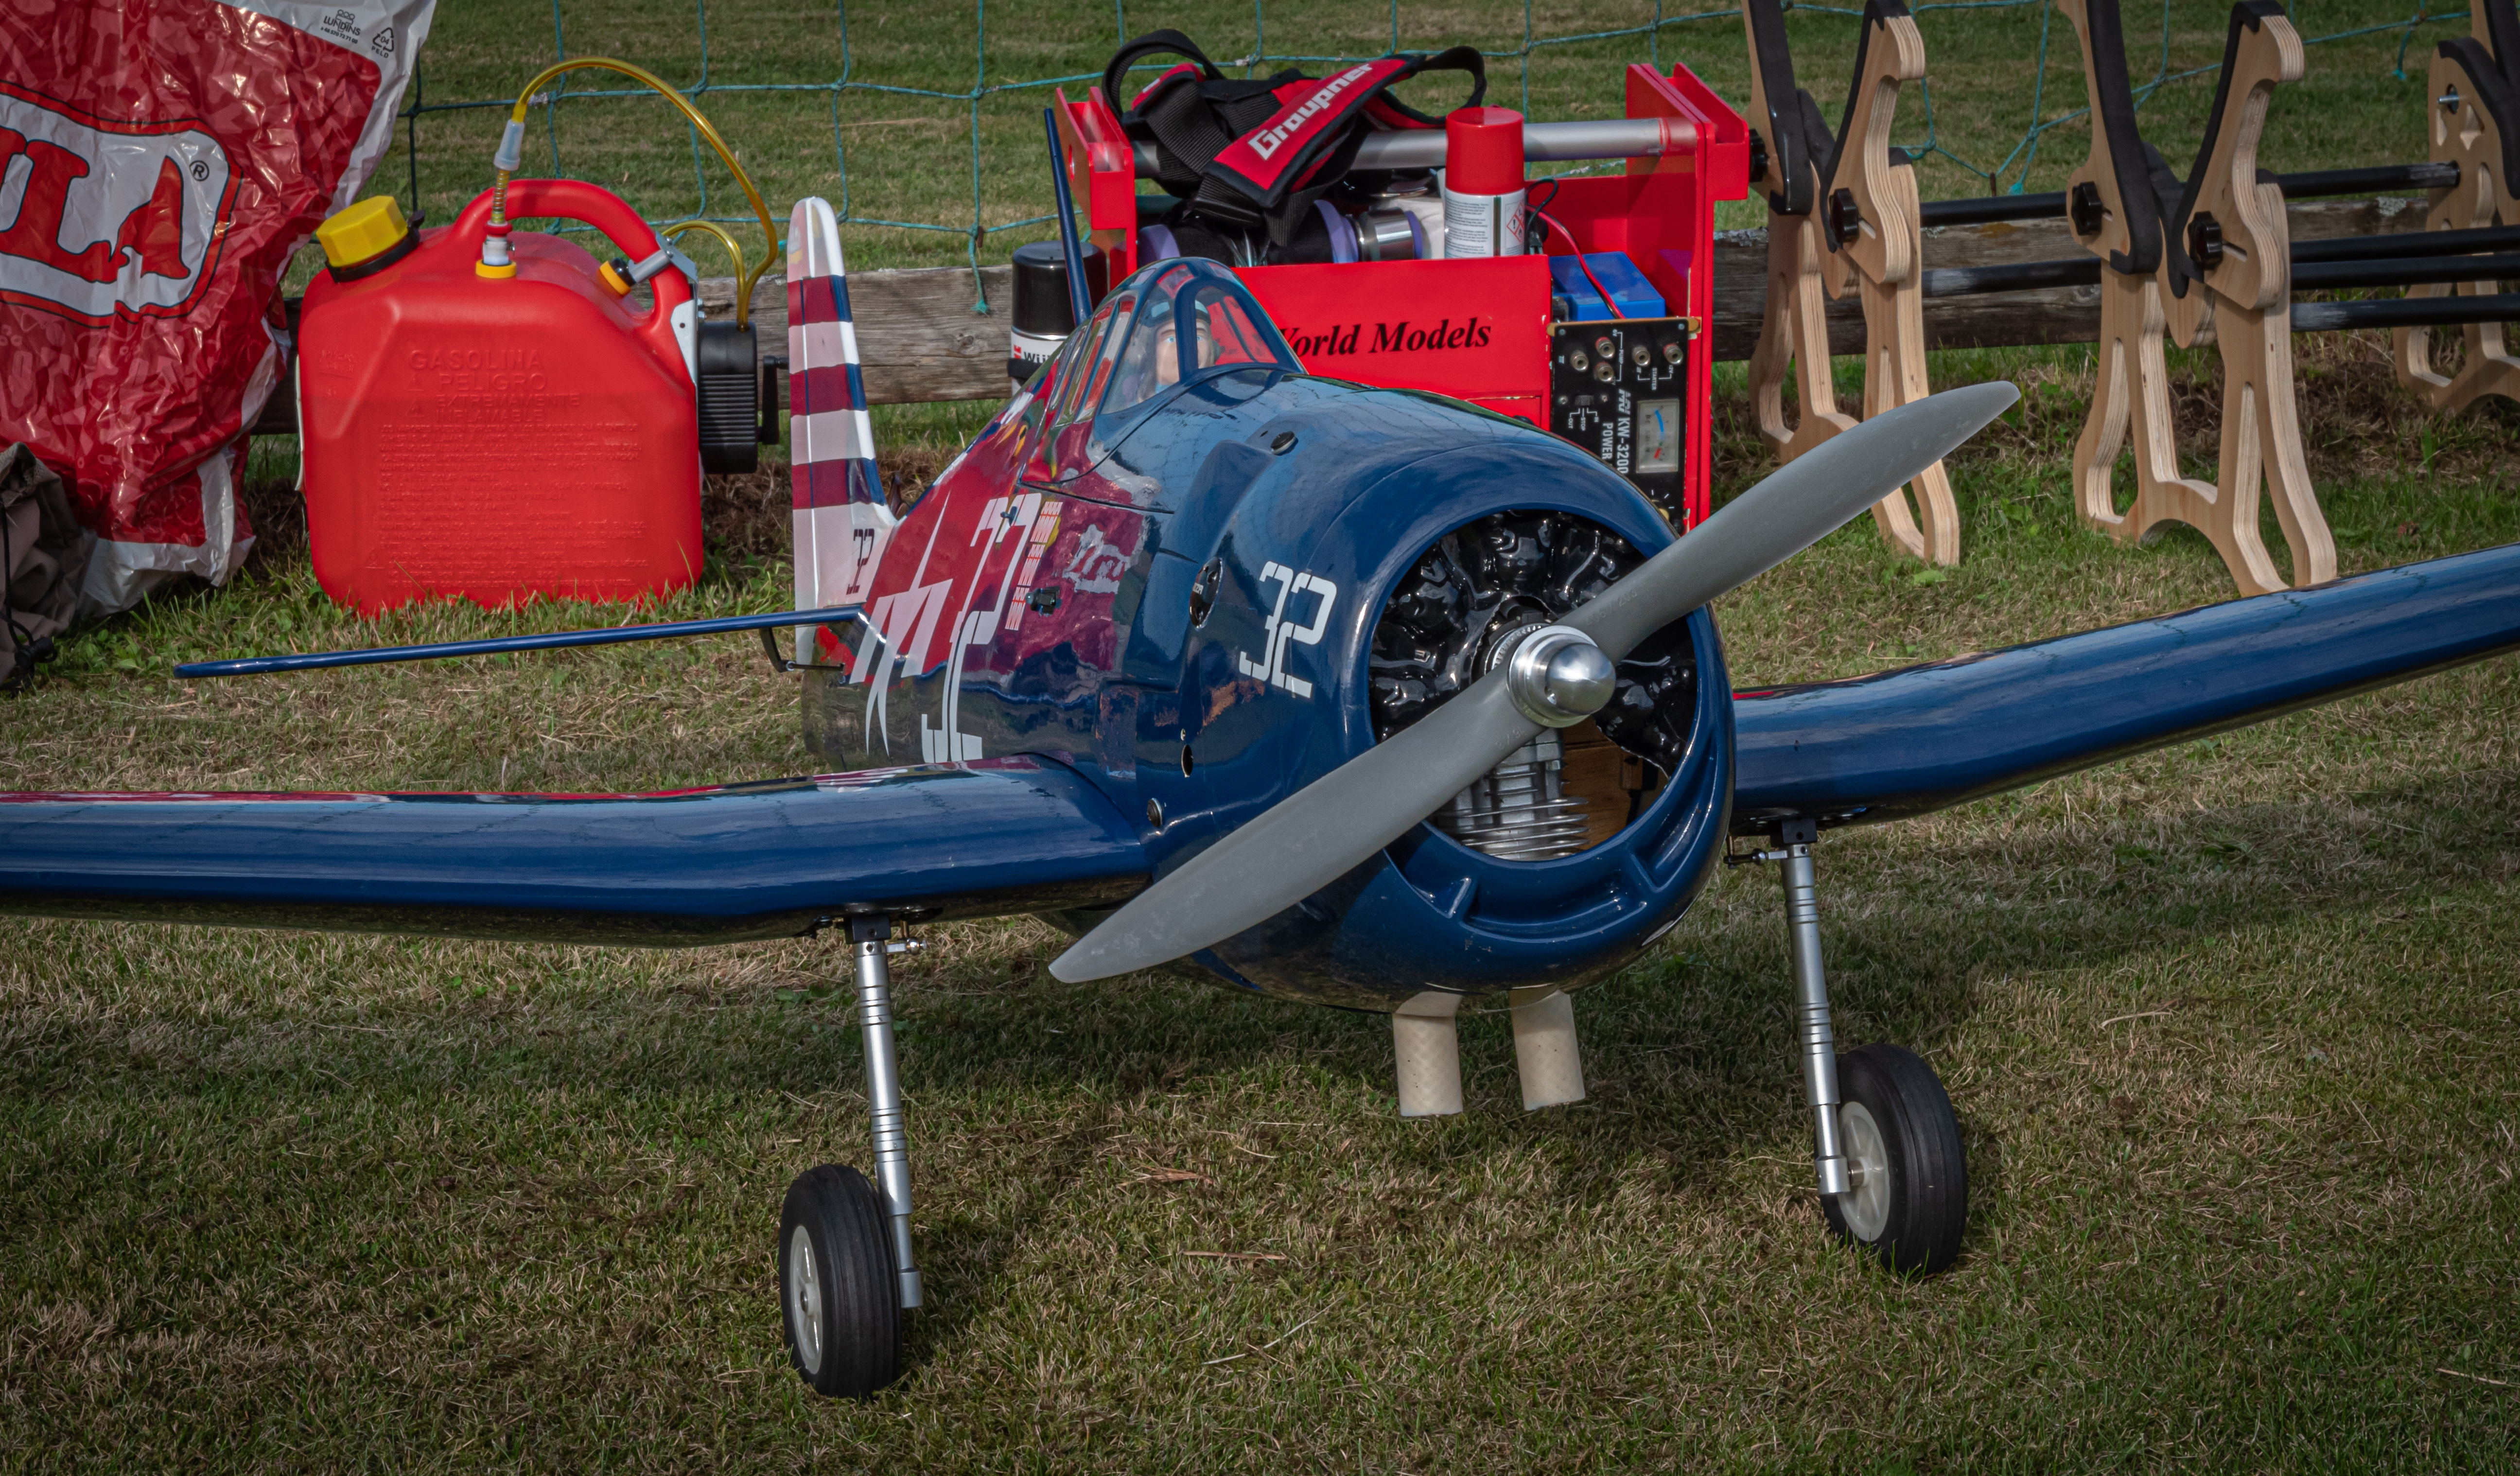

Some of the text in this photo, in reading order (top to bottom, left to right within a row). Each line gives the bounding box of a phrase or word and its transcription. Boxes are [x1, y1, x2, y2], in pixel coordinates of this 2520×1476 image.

[323, 16, 361, 36] LUNDINS
[371, 46, 389, 58] PELD
[381, 36, 389, 45] 04
[1248, 64, 1372, 160] Graupner
[1368, 317, 1491, 353] Models
[409, 349, 542, 370] GASOLINA
[439, 372, 547, 390] PELIGRO
[436, 394, 580, 407] EXTREMAMENTE
[436, 409, 544, 423] INFLAMABLE
[1602, 422, 1614, 460] POWER
[1616, 418, 1630, 474] KW-3200
[846, 528, 875, 595] 32
[921, 493, 1042, 763] 32
[1239, 561, 1337, 699] 32
